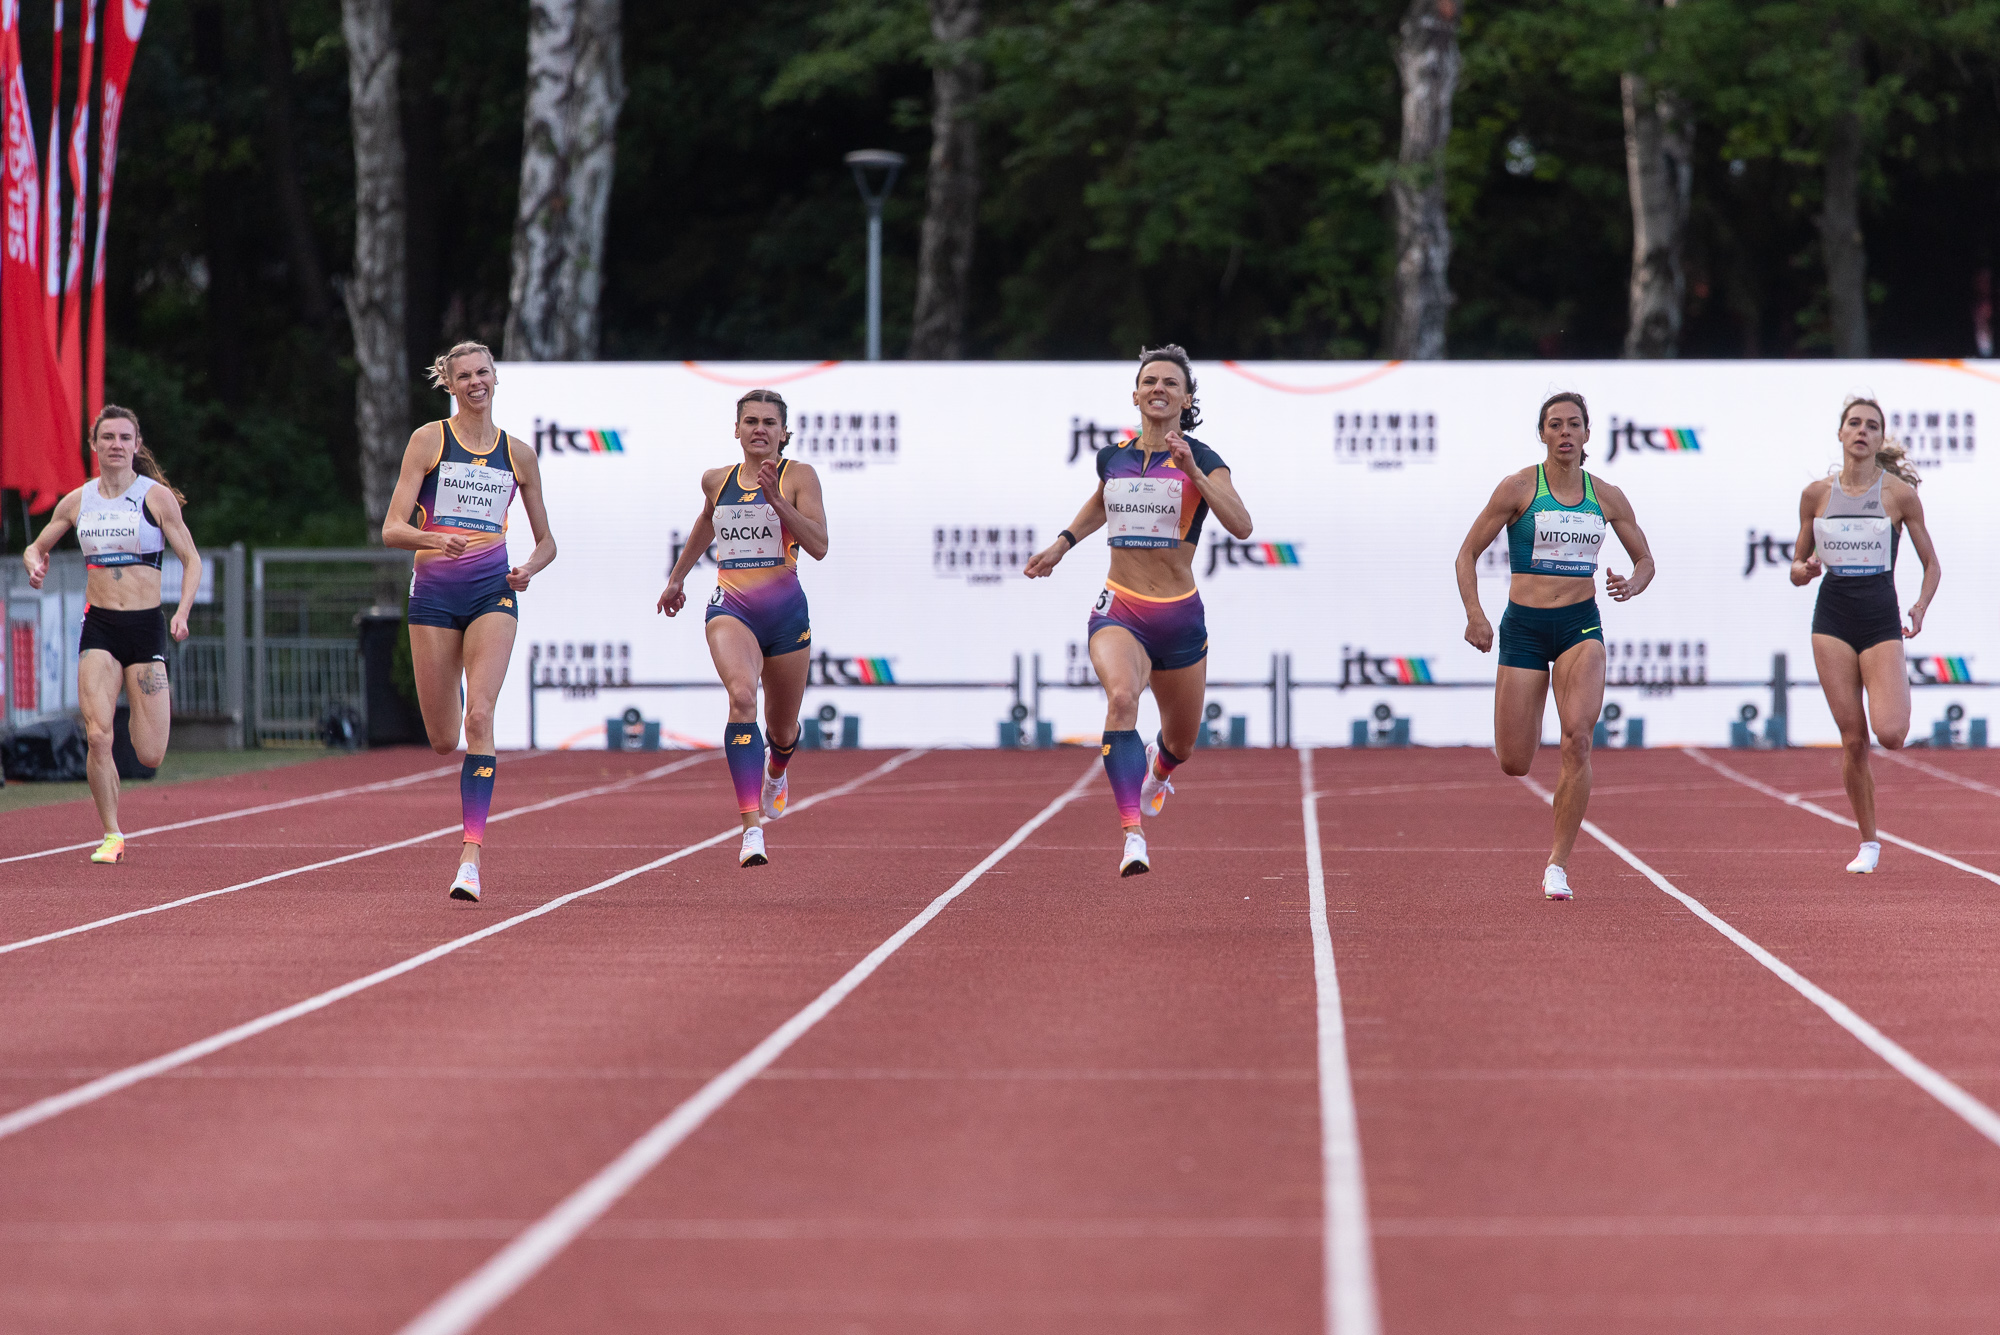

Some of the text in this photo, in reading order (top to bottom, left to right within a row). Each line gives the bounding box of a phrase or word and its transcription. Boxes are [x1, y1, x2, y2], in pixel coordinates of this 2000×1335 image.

[1605, 417, 1666, 462] jtc
[443, 478, 507, 494] BAUMGART-
[457, 494, 492, 507] WITAN
[1107, 502, 1176, 514] KIEŁBASIŃSKA
[458, 520, 484, 530] POZNAŃ
[80, 528, 135, 538] PAHLITZSCH
[720, 526, 773, 541] GACKA
[1540, 531, 1600, 545] VITORINO
[1823, 541, 1882, 551] ŁOZOWSKA
[1205, 531, 1265, 576] jtc
